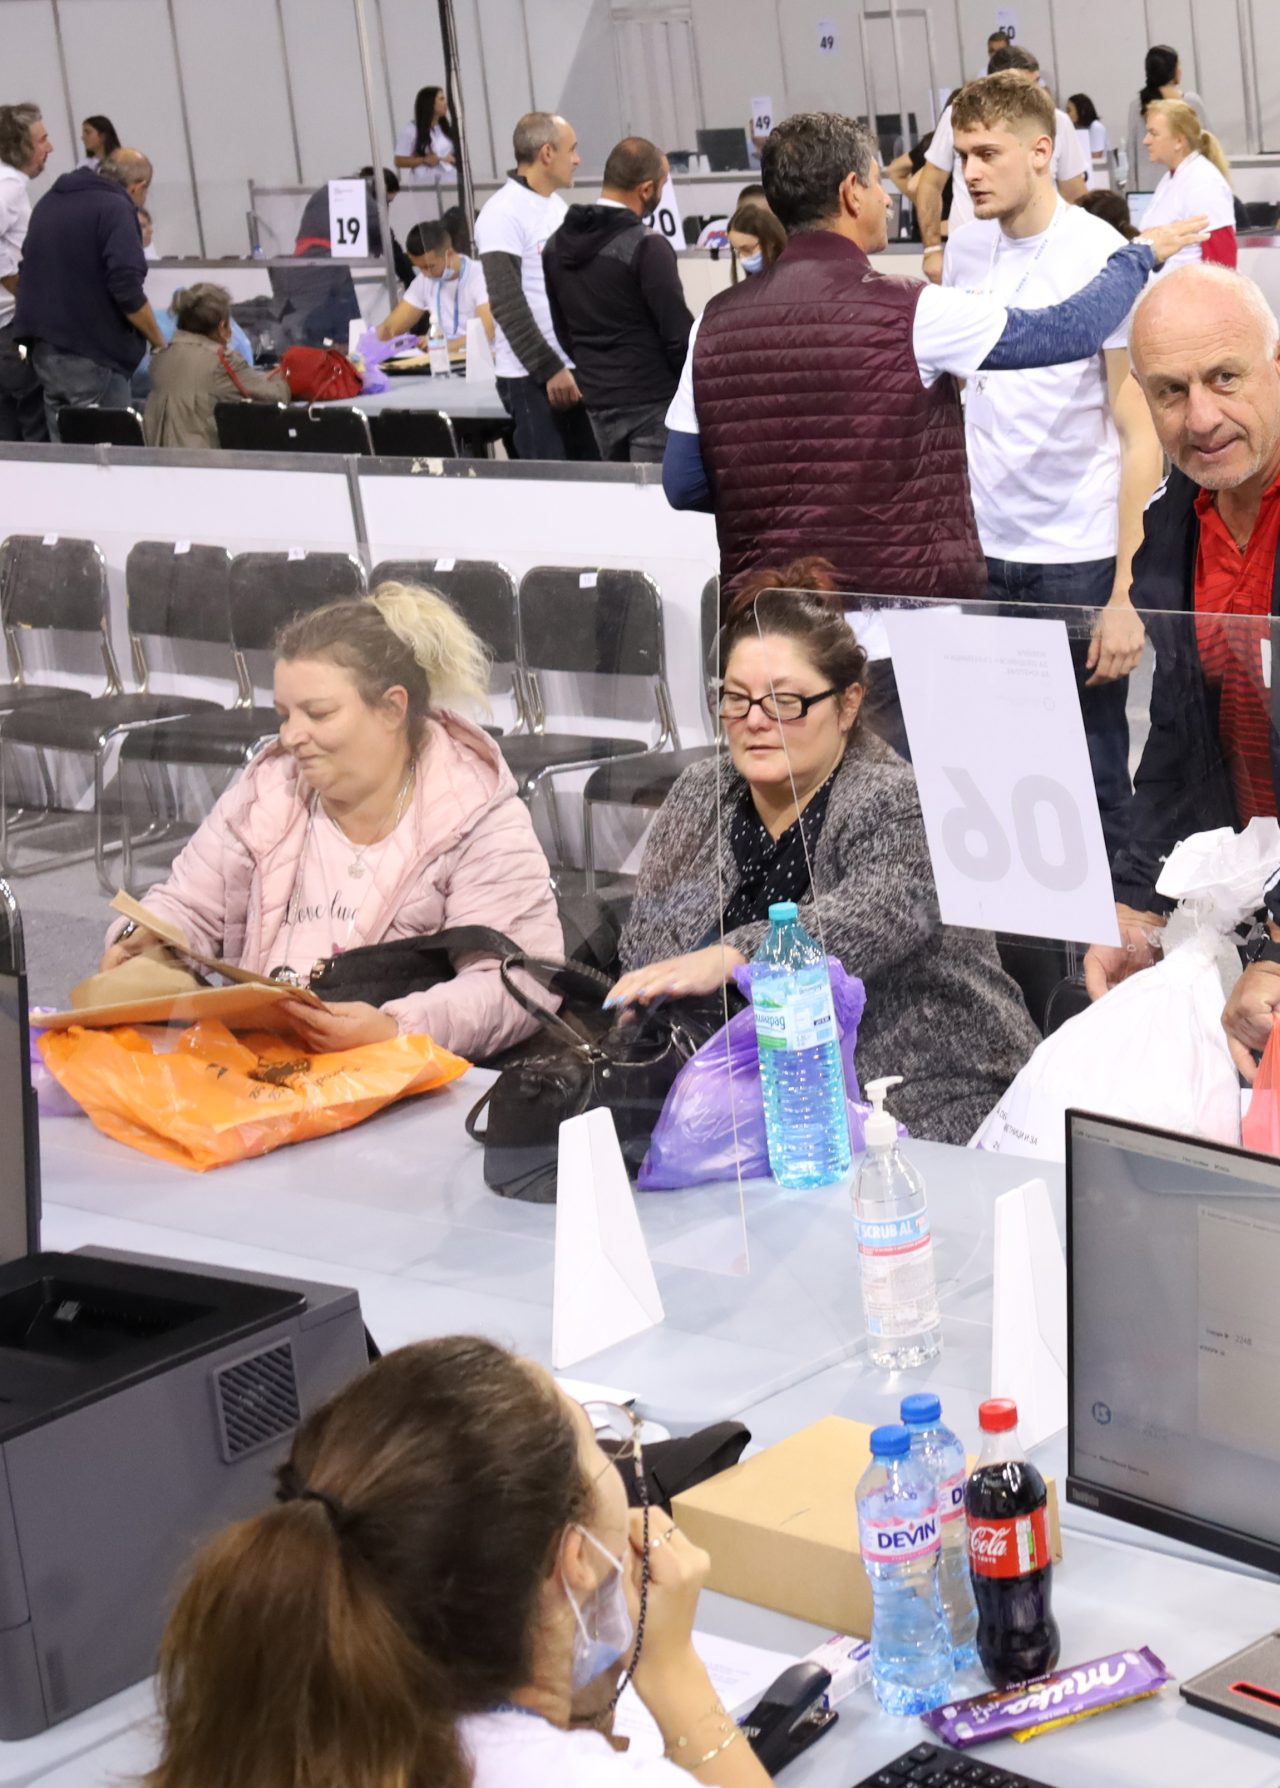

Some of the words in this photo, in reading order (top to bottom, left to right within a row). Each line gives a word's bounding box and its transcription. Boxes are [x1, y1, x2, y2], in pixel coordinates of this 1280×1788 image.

[820, 36, 834, 49] 49
[755, 116, 771, 129] 49
[337, 217, 360, 245] 19
[280, 896, 325, 927] Love
[877, 1517, 936, 1549] DEVIN
[1000, 1661, 1126, 1716] Milka
